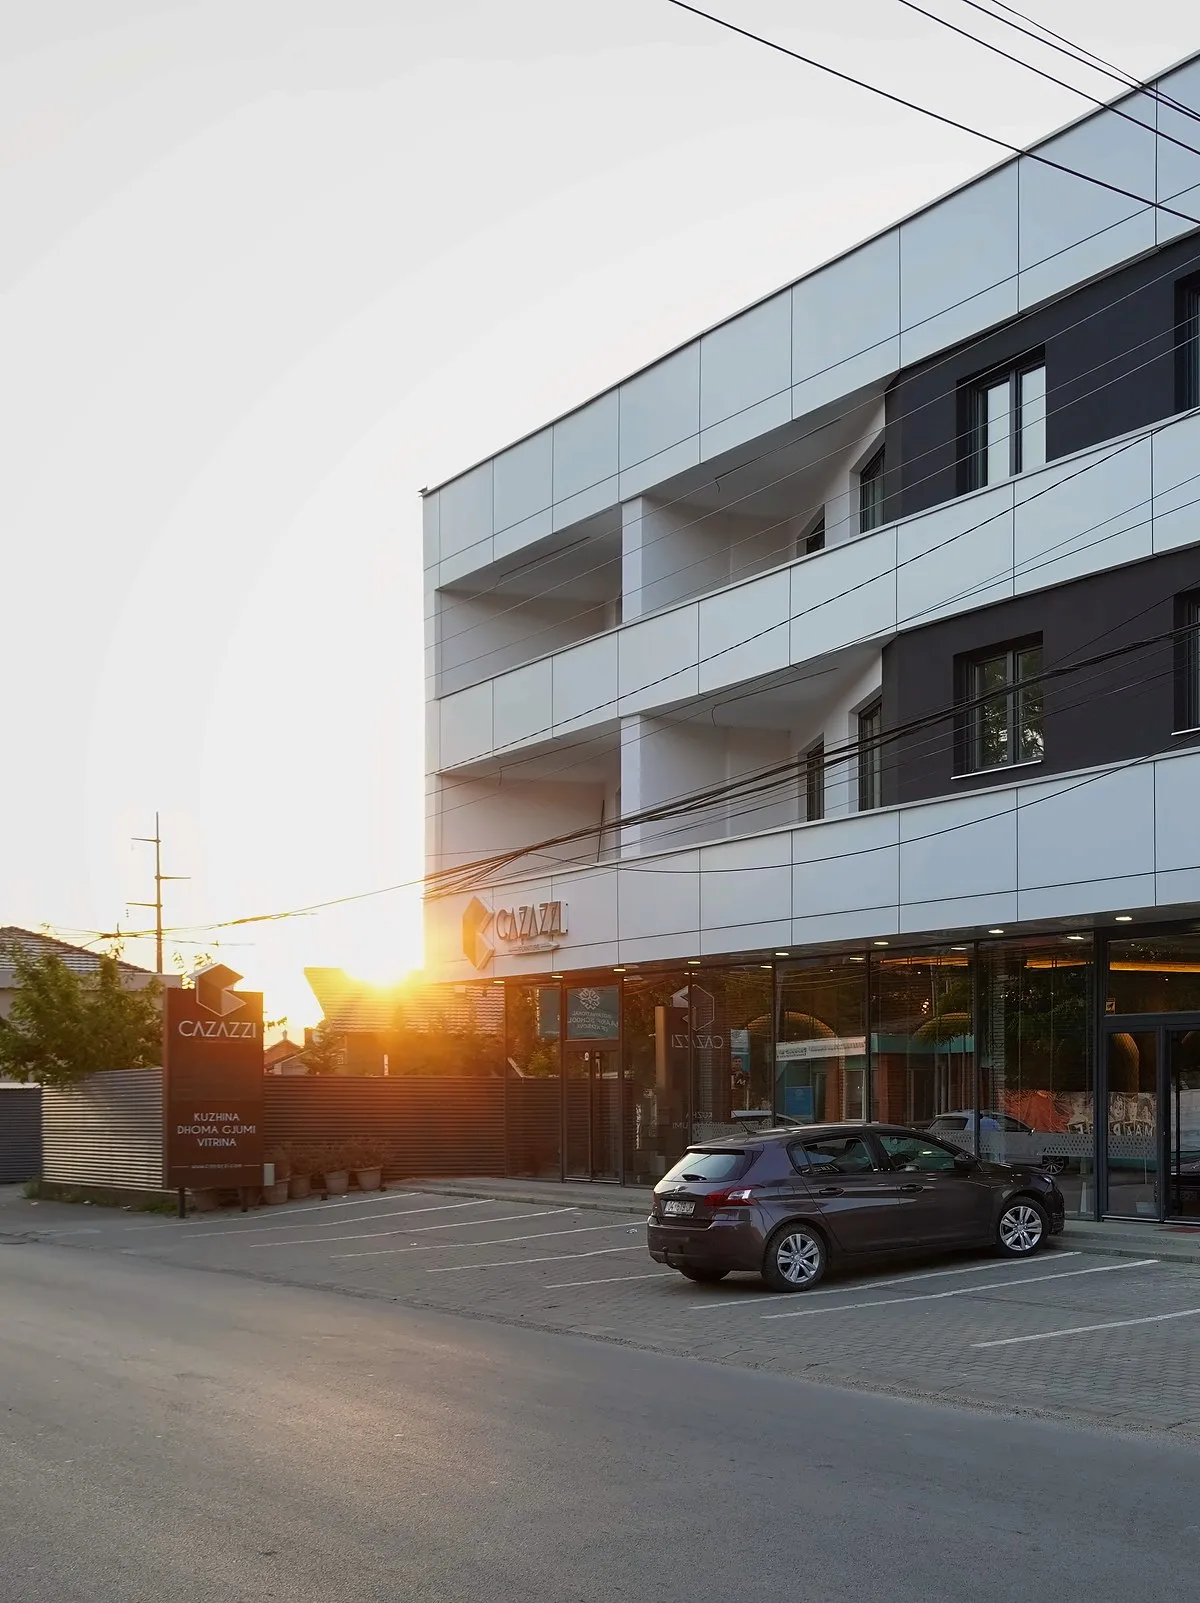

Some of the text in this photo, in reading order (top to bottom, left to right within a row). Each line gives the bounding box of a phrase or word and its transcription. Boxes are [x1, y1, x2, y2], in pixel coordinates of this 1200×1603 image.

[496, 900, 568, 941] CAZAZZI
[178, 1020, 256, 1038] CAZAZZI
[194, 1113, 240, 1122] KUZHINA
[177, 1125, 256, 1134] DHOMA GJUMI
[197, 1138, 237, 1147] VITRINA
